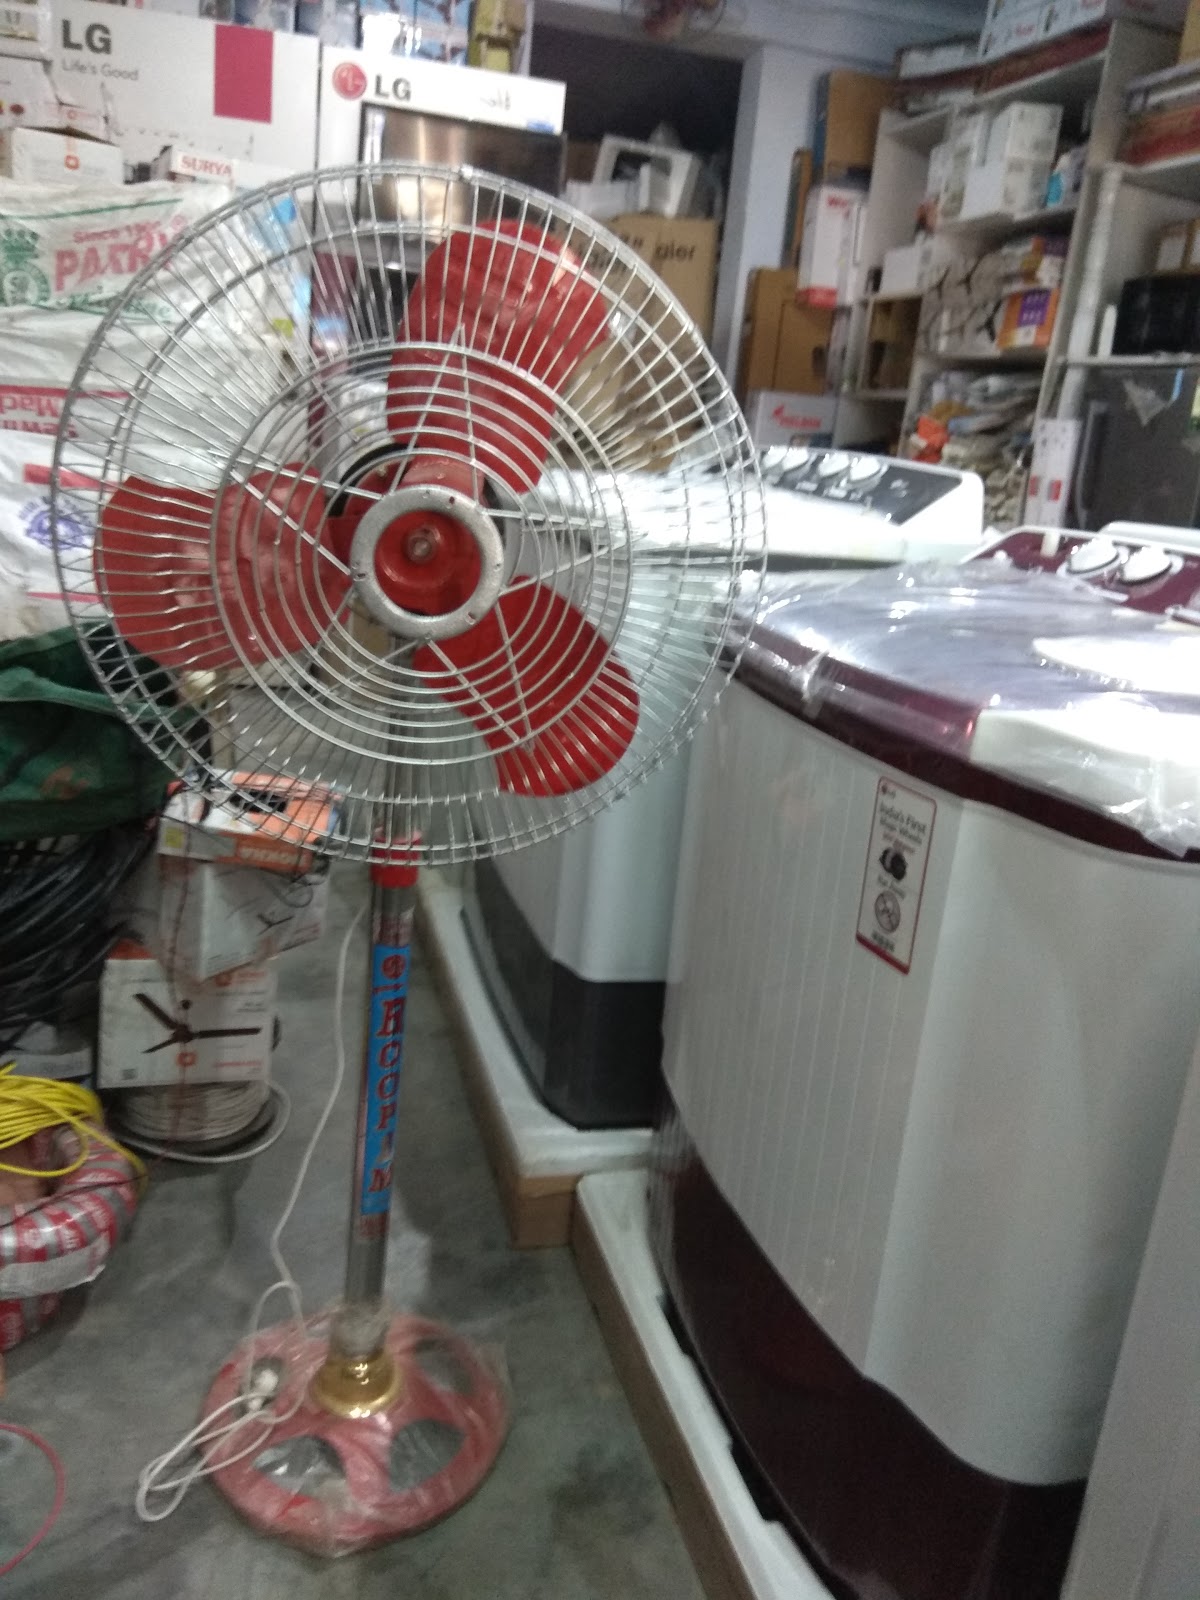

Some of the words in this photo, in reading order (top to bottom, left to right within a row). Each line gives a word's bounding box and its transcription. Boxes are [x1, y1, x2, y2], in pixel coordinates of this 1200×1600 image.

[62, 19, 112, 55] LG
[62, 58, 97, 75] Life's
[101, 63, 139, 81] Good
[374, 74, 412, 101] LG
[180, 155, 233, 178] SURYA
